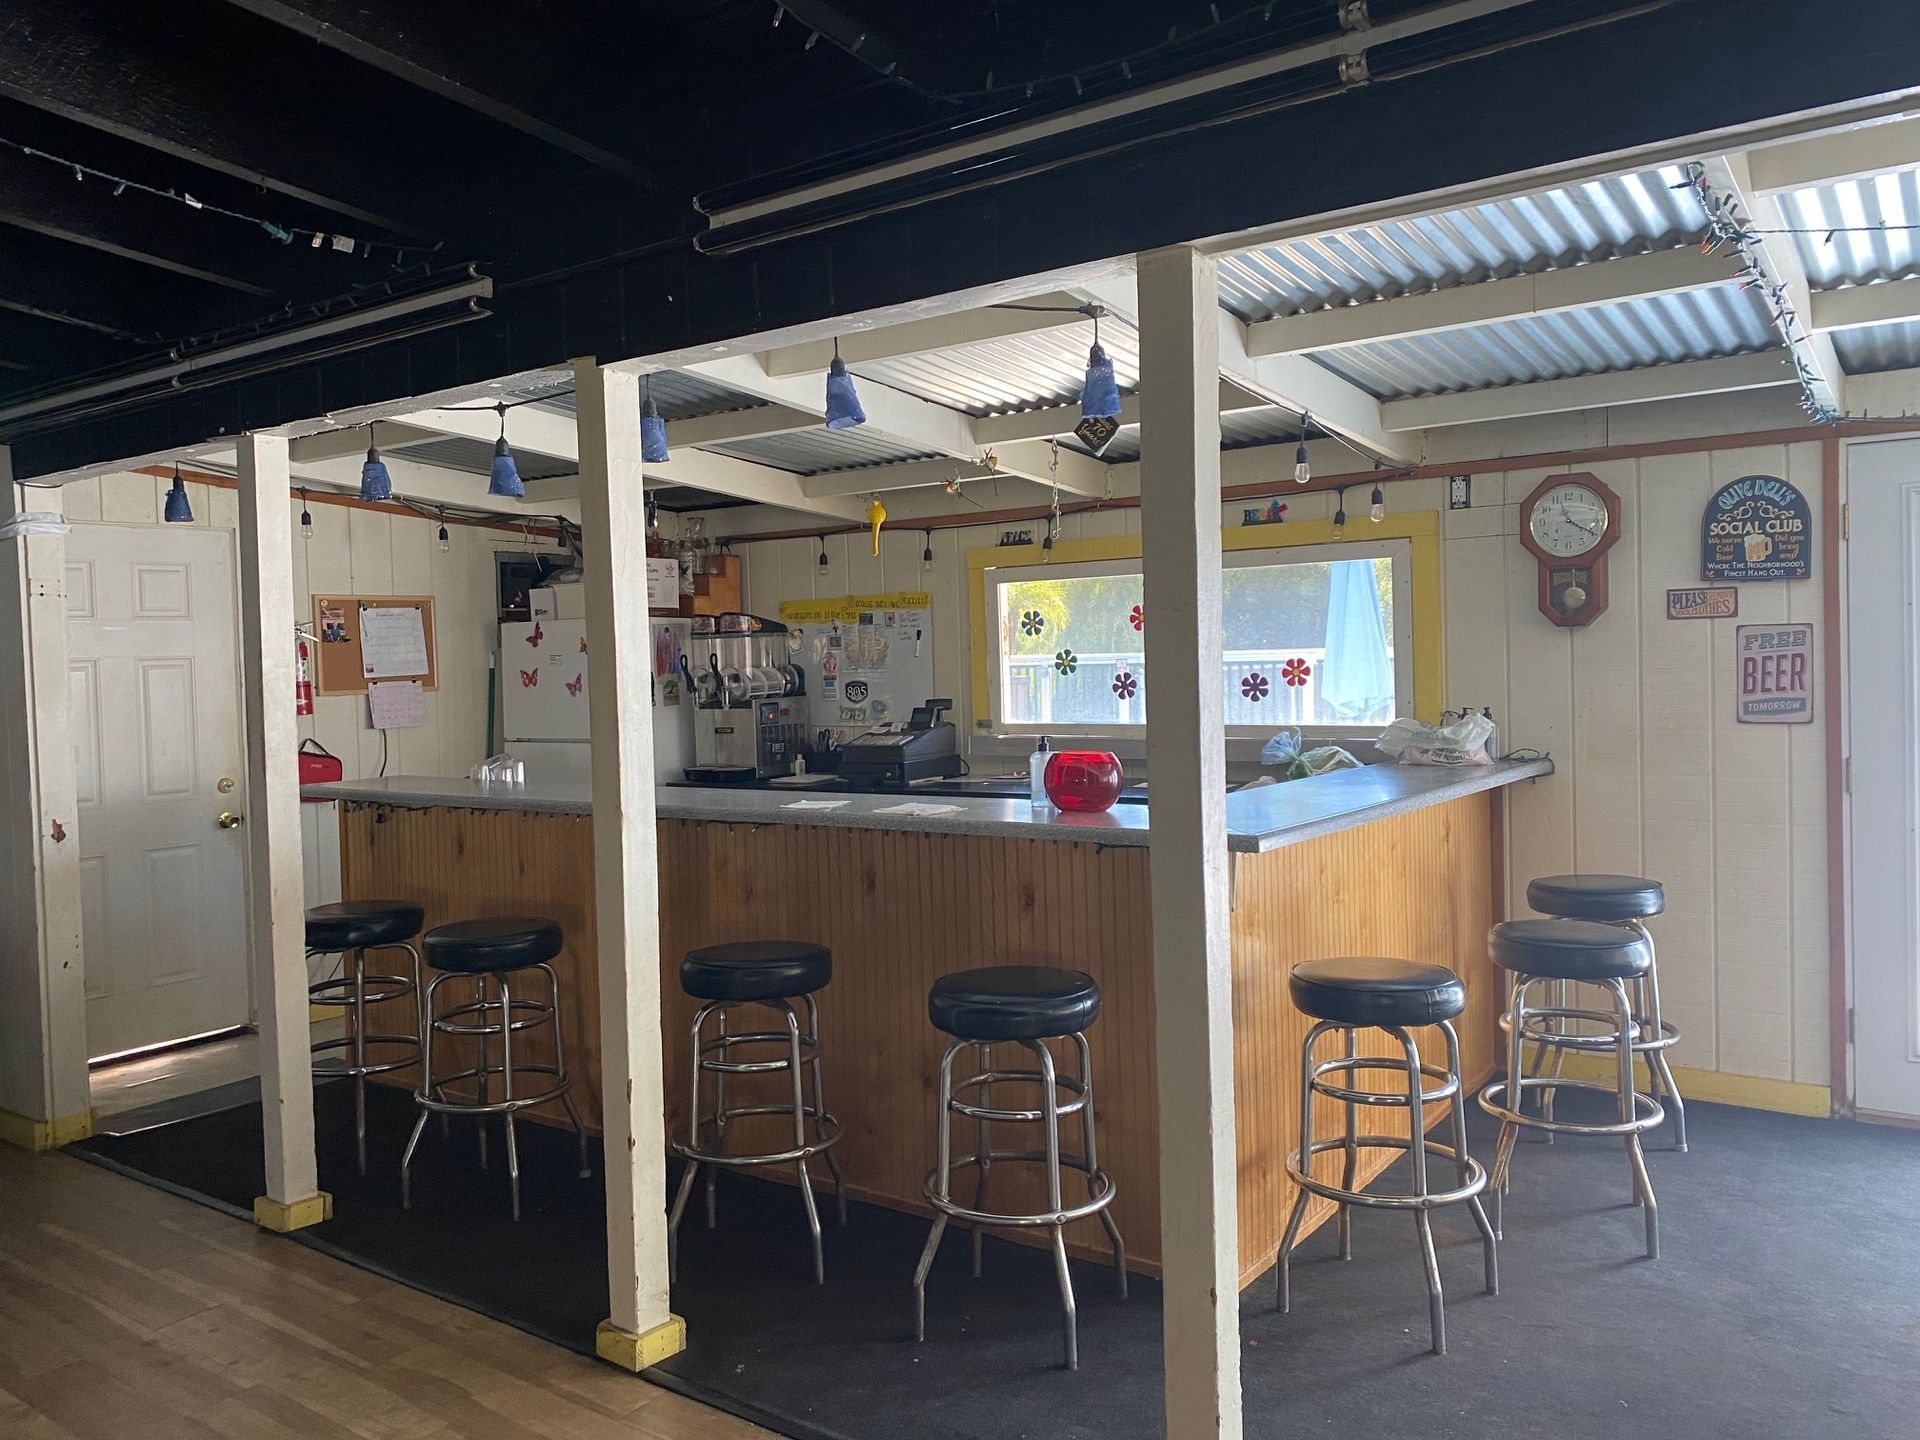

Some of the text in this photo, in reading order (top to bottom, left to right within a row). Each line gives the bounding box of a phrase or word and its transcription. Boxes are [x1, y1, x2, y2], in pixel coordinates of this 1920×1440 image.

[1092, 422, 1107, 437] 70
[1552, 495, 1559, 504] 11
[1564, 492, 1573, 501] 12
[1580, 493, 1583, 503] 1
[1718, 480, 1797, 509] OLIVE DELL'S
[1542, 506, 1551, 514] 10
[1539, 518, 1546, 527] 9
[1710, 519, 1803, 535] SOCIAL CLUB
[1553, 538, 1559, 548] 7
[1790, 535, 1804, 544] you
[1565, 541, 1573, 550] 6
[1716, 544, 1733, 553] Cold
[1780, 543, 1799, 553] bring
[1716, 553, 1733, 561] Beer
[1732, 561, 1745, 569] THE
[1748, 569, 1767, 577] HANG
[1672, 592, 1708, 609] PLEASE
[1690, 600, 1731, 615] CLOTHES
[1743, 630, 1807, 651] FREE
[1743, 653, 1806, 694] BEER
[847, 686, 867, 699] 805
[1747, 701, 1801, 713] TOMORROW
